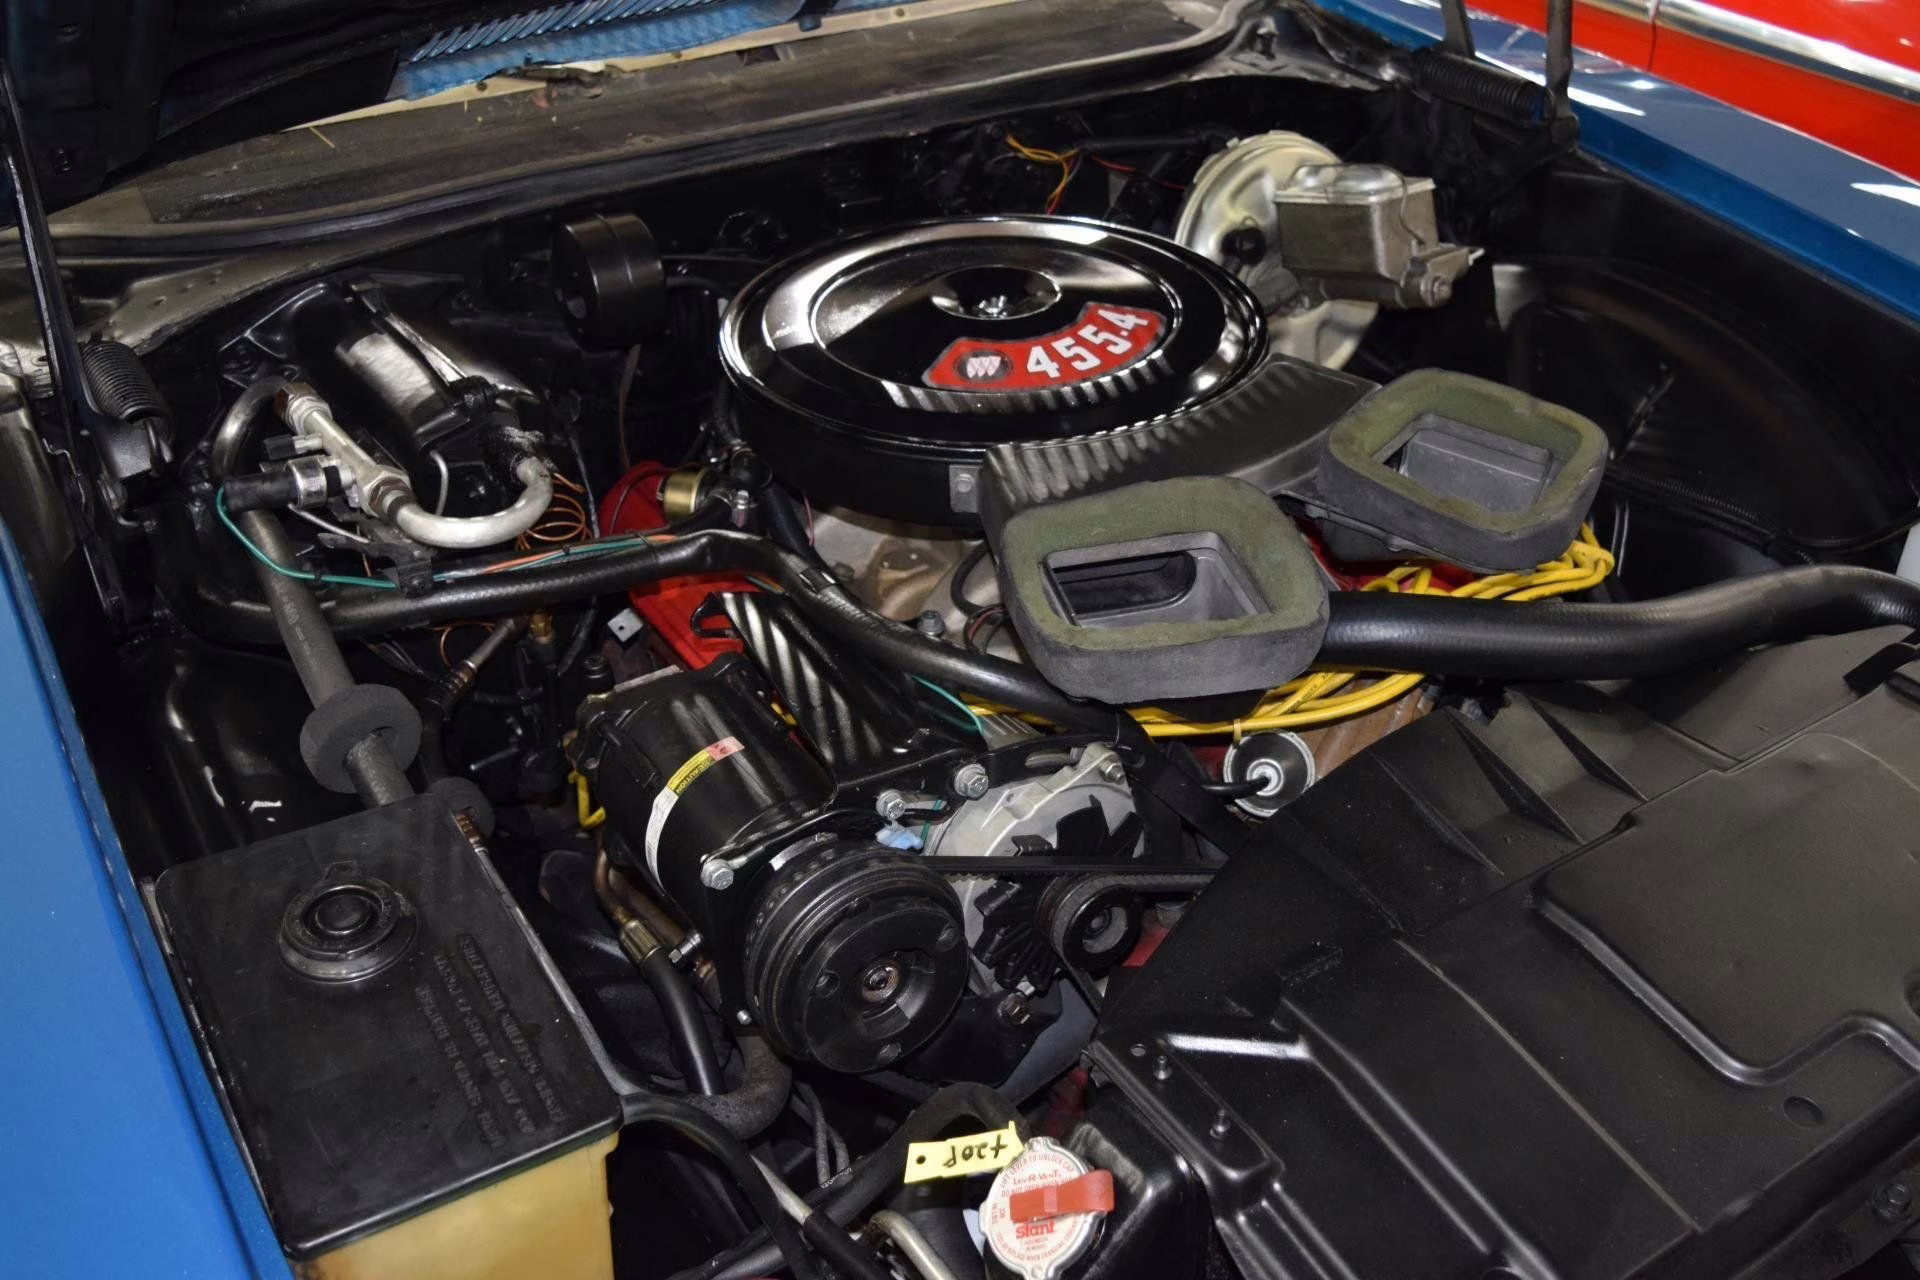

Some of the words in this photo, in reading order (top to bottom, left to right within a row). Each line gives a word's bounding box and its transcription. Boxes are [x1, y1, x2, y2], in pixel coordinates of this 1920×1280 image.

[675, 764, 705, 795] CAUTION
[1010, 1158, 1028, 1175] LEVER
[1029, 1154, 1037, 1163] TO
[1038, 1153, 1063, 1165] UNLOCK
